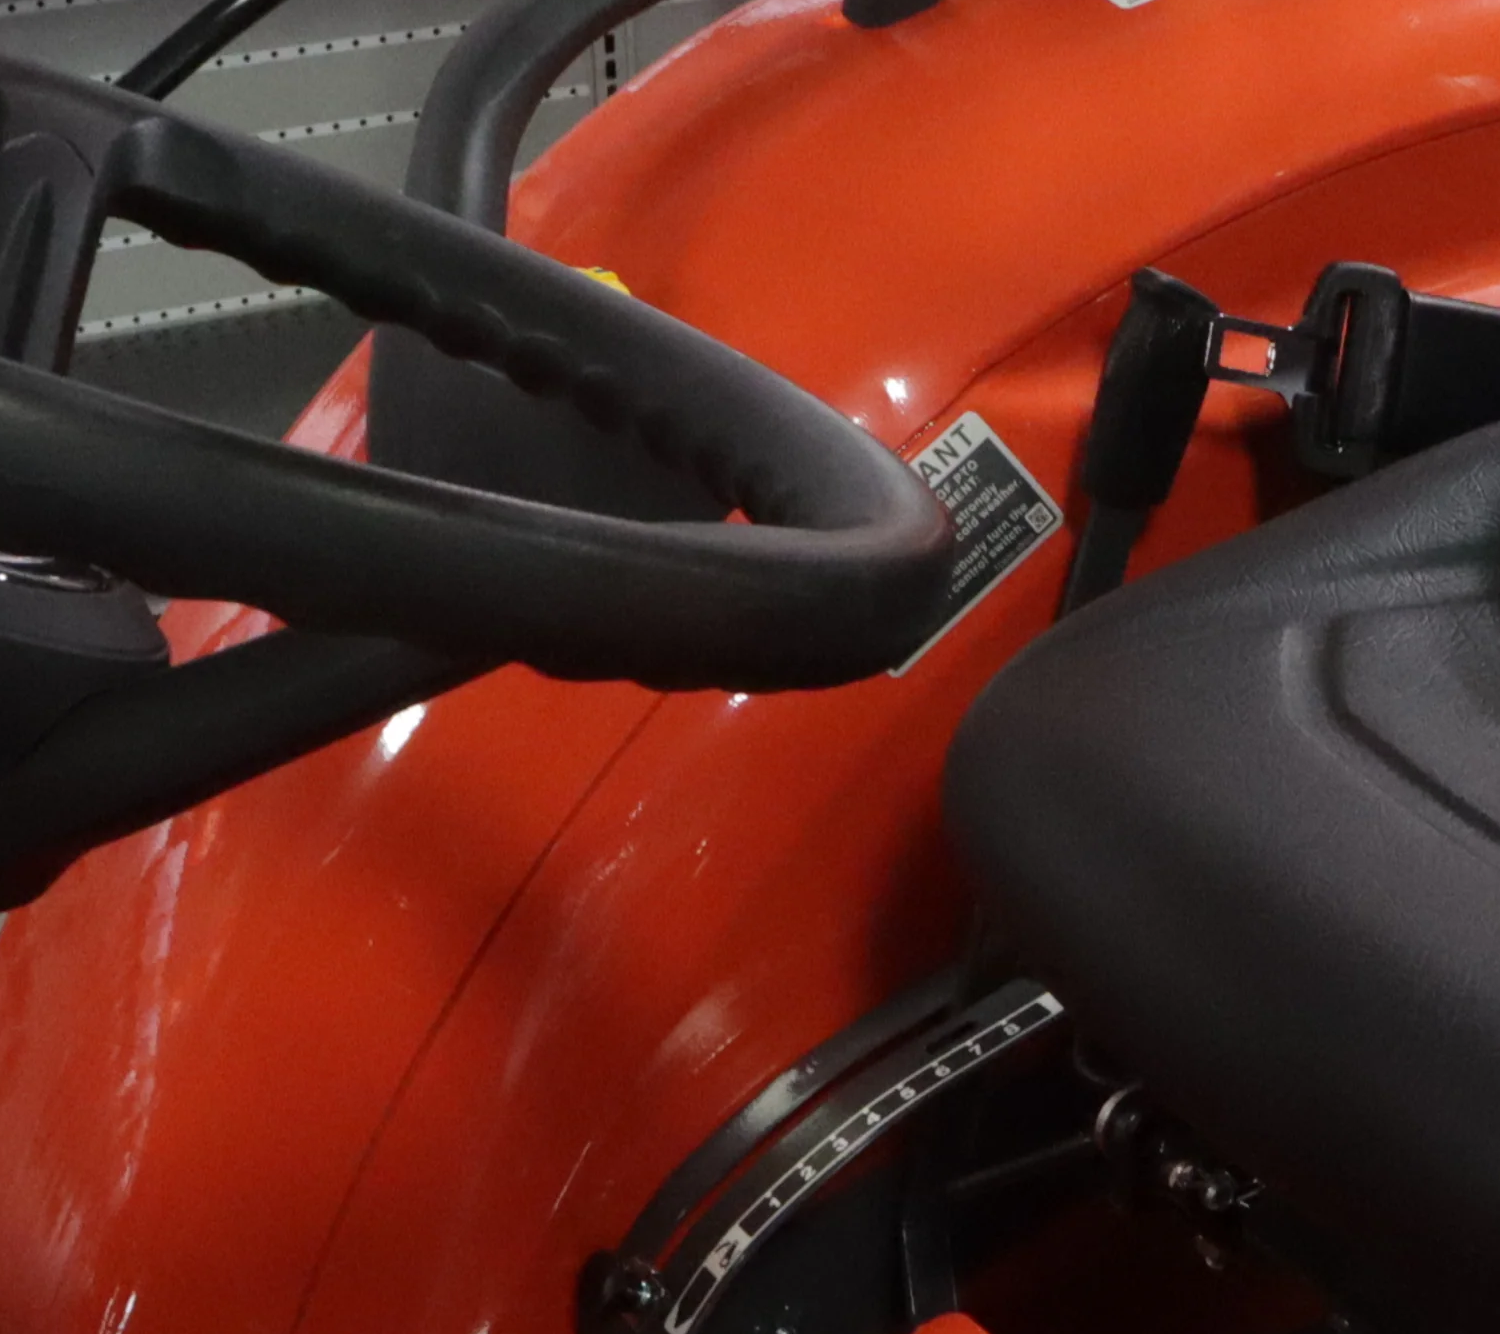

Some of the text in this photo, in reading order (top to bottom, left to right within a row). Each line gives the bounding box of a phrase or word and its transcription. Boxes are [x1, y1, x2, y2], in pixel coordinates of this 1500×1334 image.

[951, 458, 979, 484] PTO
[952, 483, 999, 524] strongly
[953, 516, 980, 542] cold
[985, 519, 1010, 542] turn
[1008, 502, 1029, 521] the
[950, 557, 989, 592] control
[1003, 1022, 1021, 1037] 8
[968, 1043, 983, 1057] 7
[935, 1064, 951, 1078] 6
[900, 1085, 916, 1100] 5
[866, 1111, 882, 1126] 4
[833, 1138, 849, 1152] 3
[801, 1165, 816, 1181] 2
[768, 1196, 781, 1209] 1
